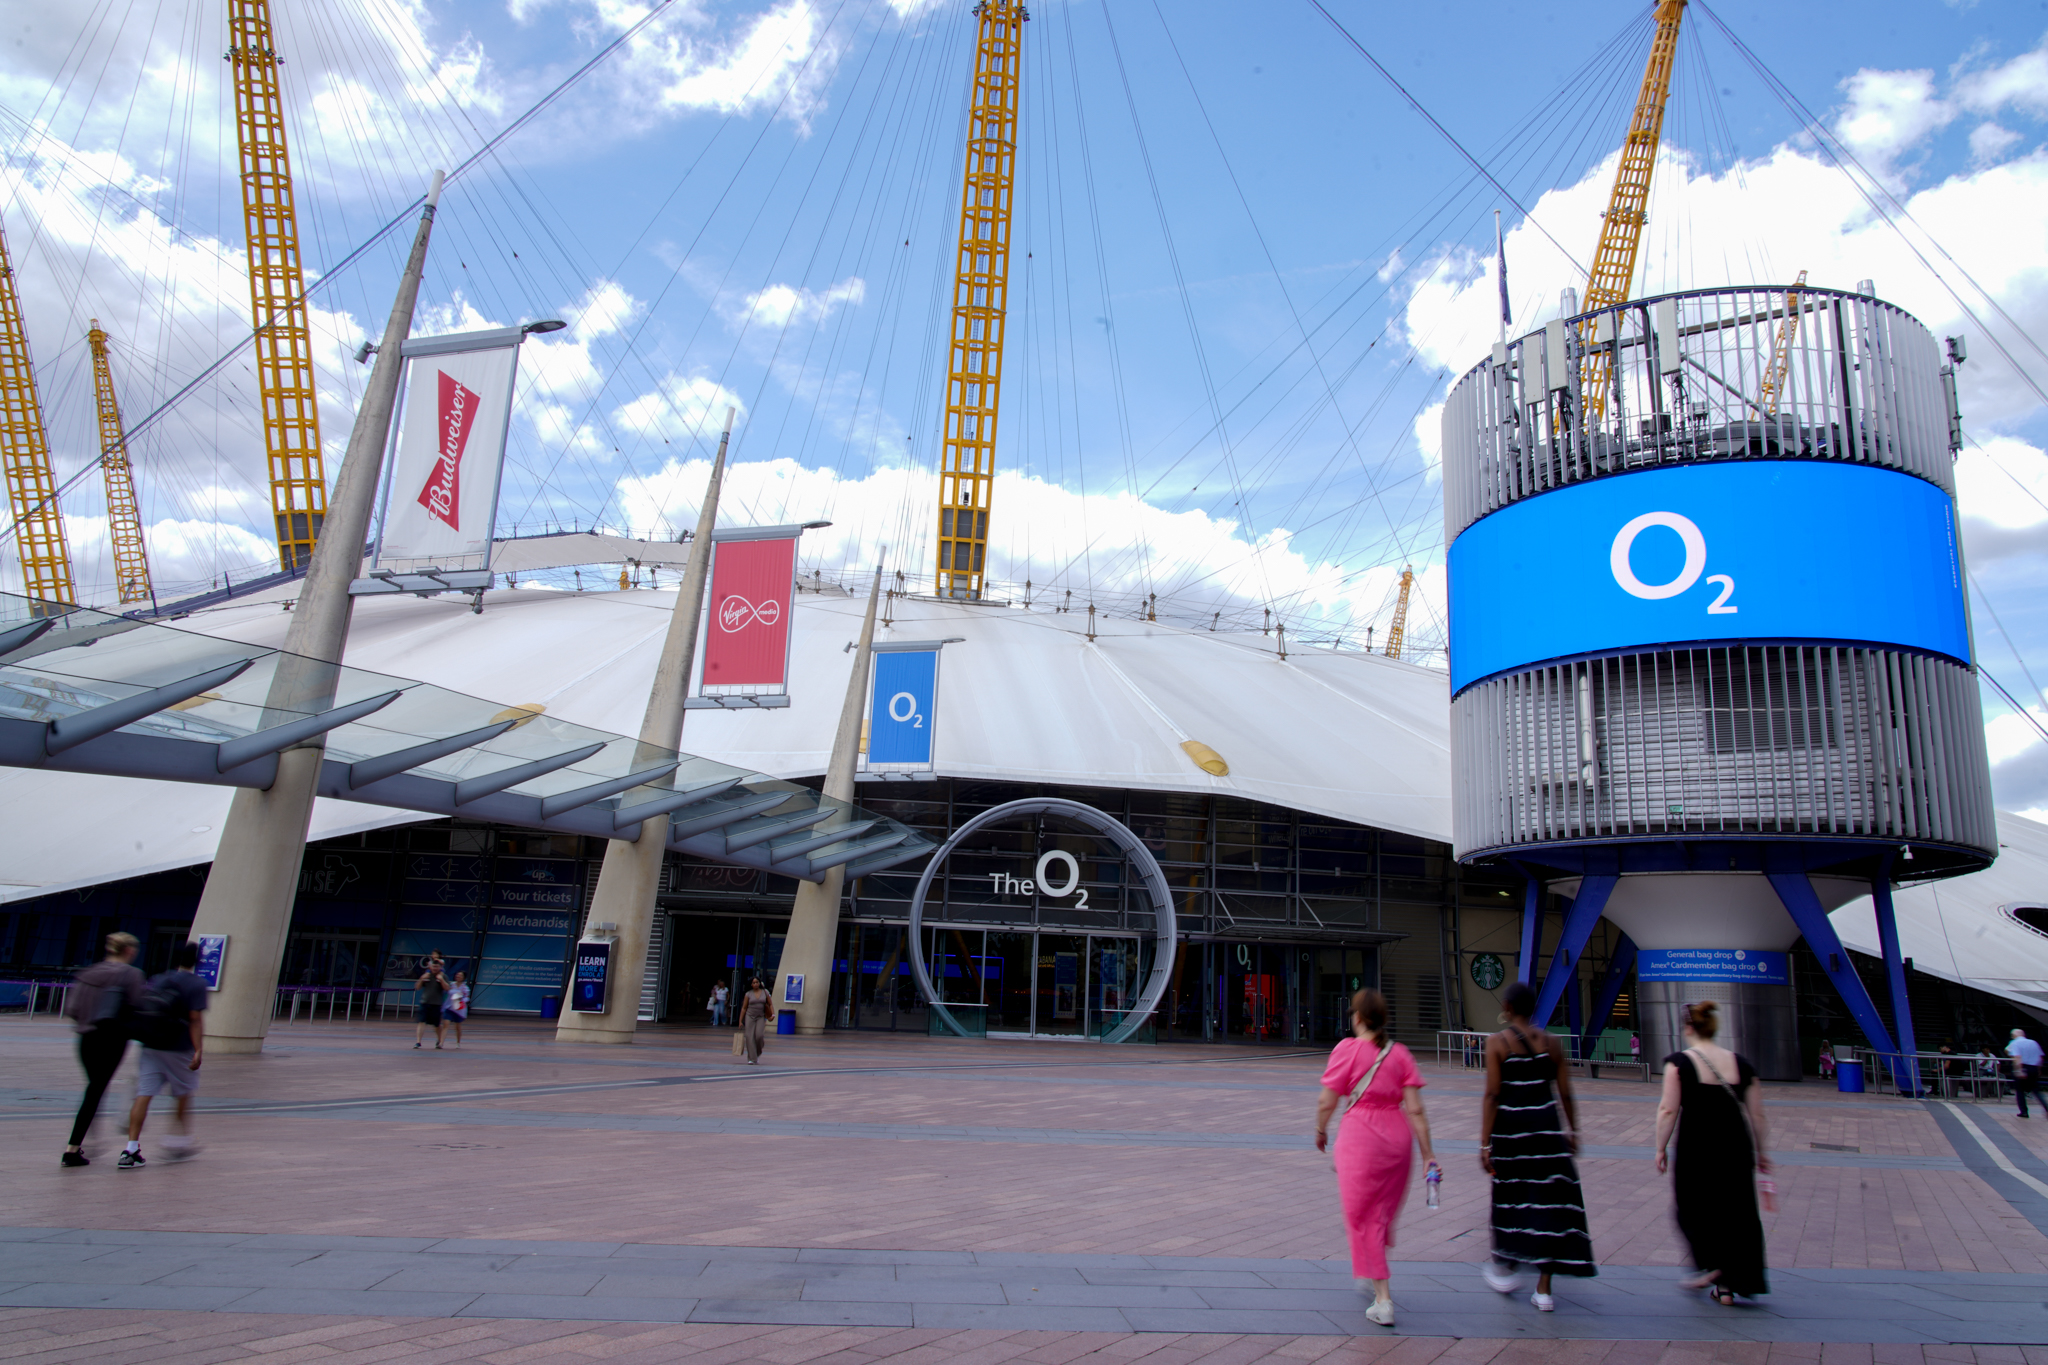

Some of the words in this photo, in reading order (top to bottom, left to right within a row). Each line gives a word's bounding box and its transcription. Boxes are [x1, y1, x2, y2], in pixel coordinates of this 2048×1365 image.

[428, 382, 465, 522] Budweiser
[1610, 510, 1738, 615] O2
[723, 602, 749, 626] Virgin
[888, 692, 923, 729] O2
[988, 872, 1034, 896] The
[1035, 849, 1089, 910] O2
[501, 889, 530, 901] Your
[533, 890, 572, 903] tickets
[492, 914, 569, 928] Merchandise
[579, 956, 606, 966] LEARN
[1697, 951, 1712, 960] bag
[1714, 951, 1733, 960] drop
[387, 957, 418, 971] Only
[1722, 963, 1737, 972] bag
[1739, 963, 1756, 972] drop
